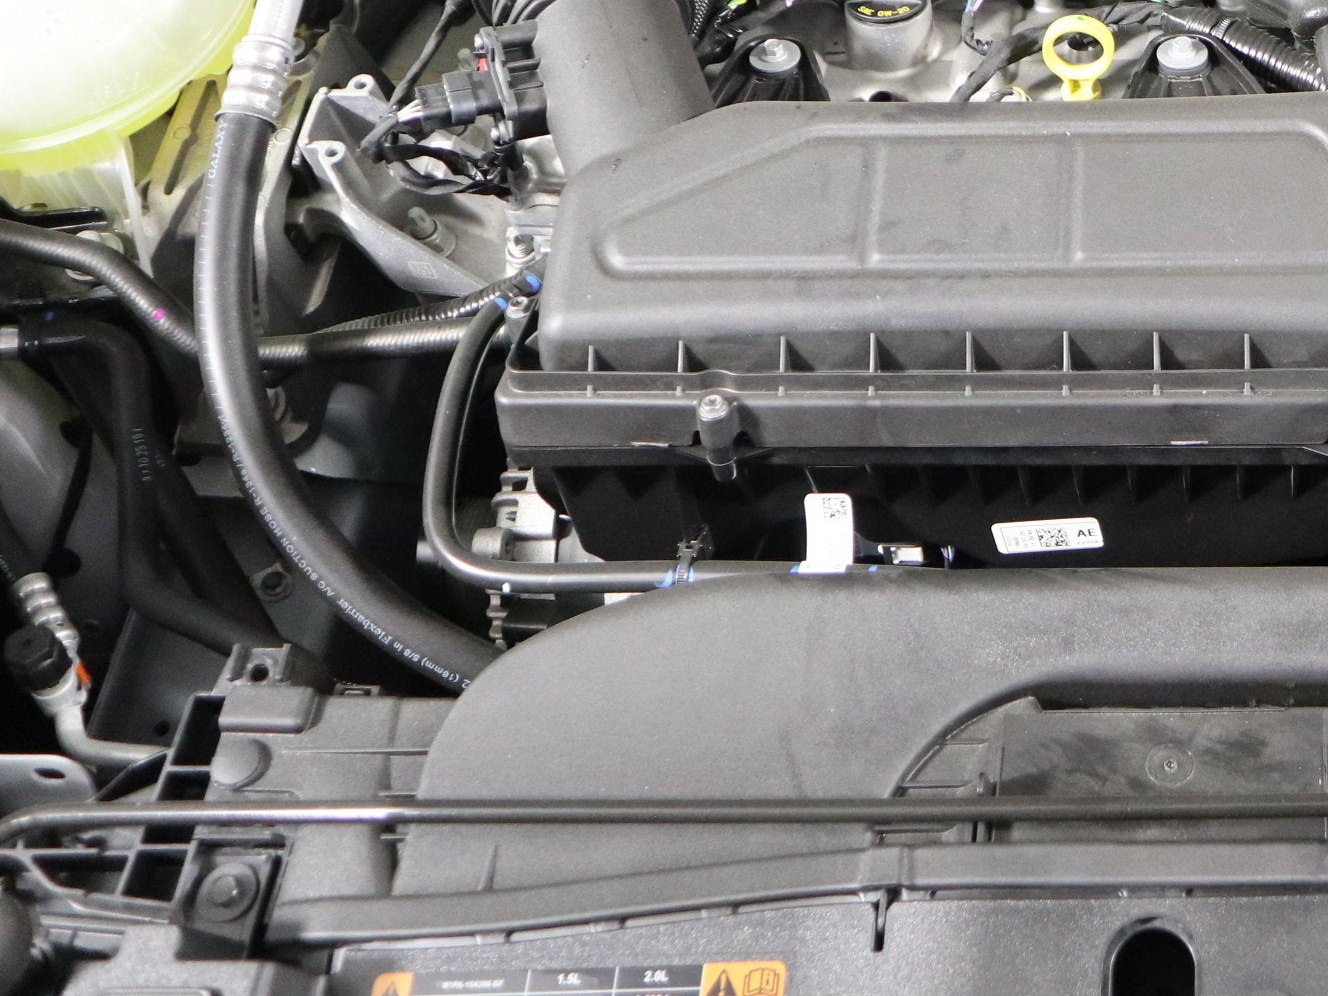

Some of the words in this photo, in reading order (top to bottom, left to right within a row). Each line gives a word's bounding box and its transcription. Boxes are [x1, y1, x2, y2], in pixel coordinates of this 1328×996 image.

[856, 5, 875, 16] SAE
[208, 118, 228, 178] GALAXY
[261, 507, 282, 537] HOSE
[1077, 528, 1097, 538] AE
[280, 537, 317, 580] SUCTION
[318, 581, 335, 596] A/C
[336, 599, 393, 644] Flexbarrier
[403, 649, 420, 662] 5/8
[421, 652, 460, 683] (16mm)
[643, 969, 669, 982] 2.0L
